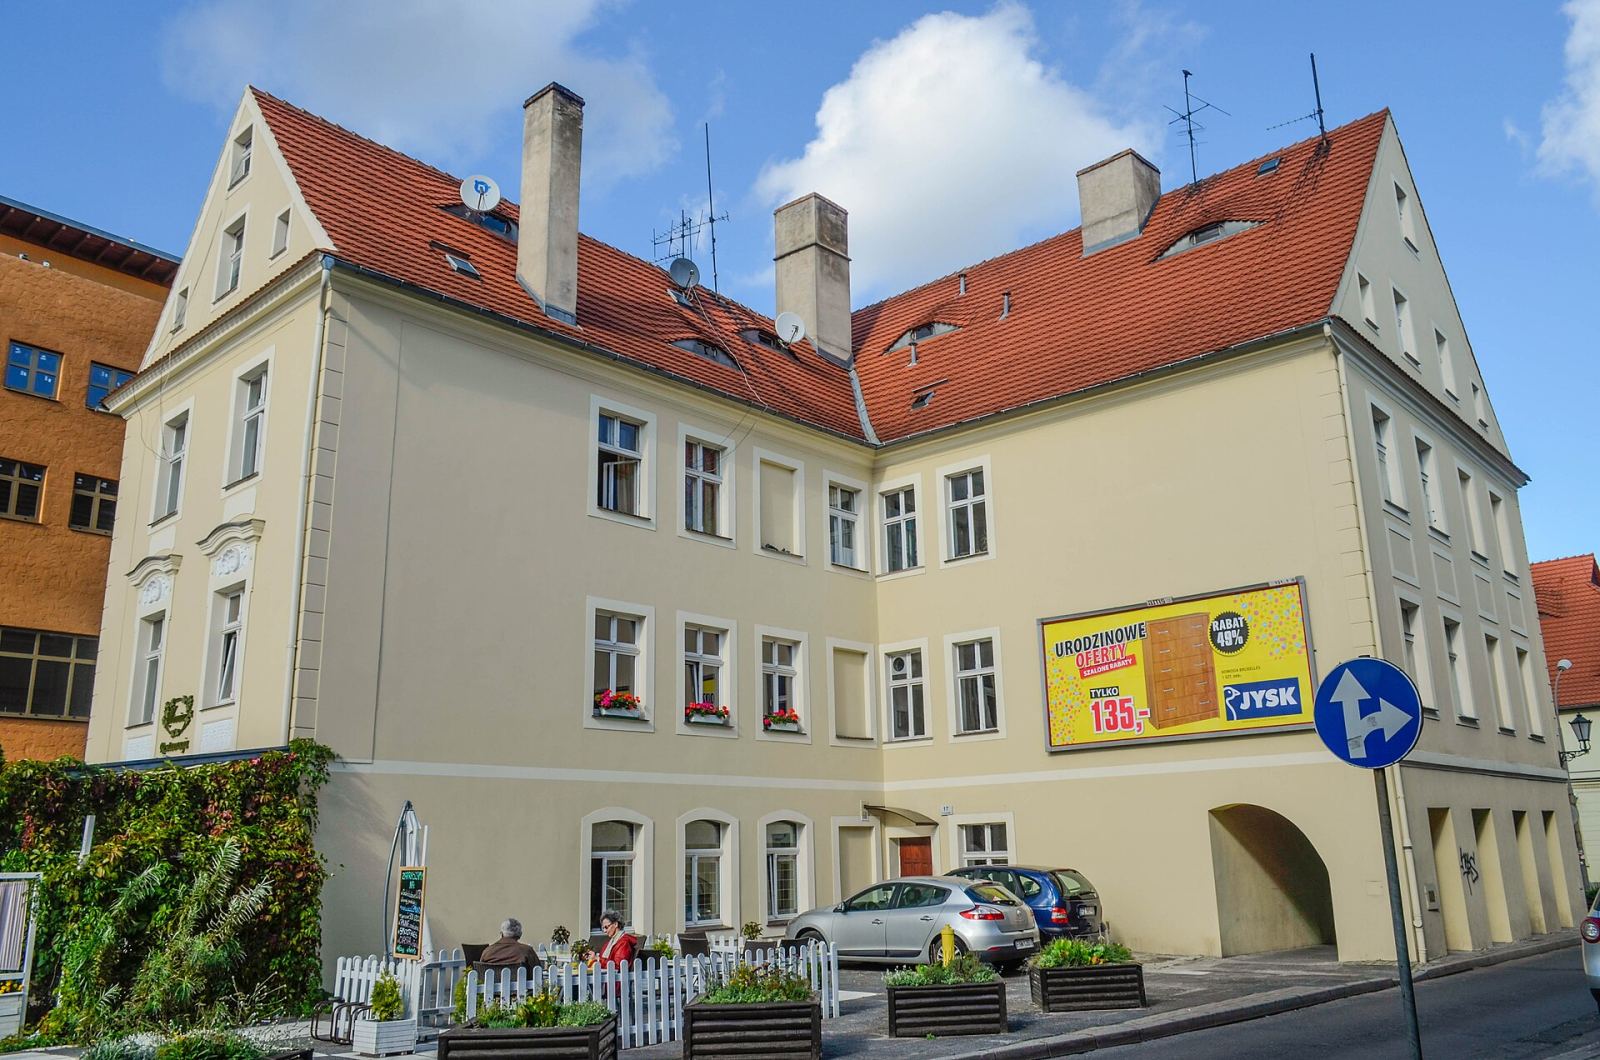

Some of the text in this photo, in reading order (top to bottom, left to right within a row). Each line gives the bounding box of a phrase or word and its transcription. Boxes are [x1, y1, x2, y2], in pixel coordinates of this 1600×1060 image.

[1212, 617, 1244, 631] RABAT
[1055, 622, 1146, 657] URODZINOWE
[1217, 629, 1243, 647] 49%
[1076, 643, 1126, 668] OFERTY
[1083, 658, 1132, 677] SZALONE RABATY
[1090, 687, 1119, 698] TYLKO
[1240, 686, 1298, 710] JYSK
[1091, 697, 1150, 733] 135,-
